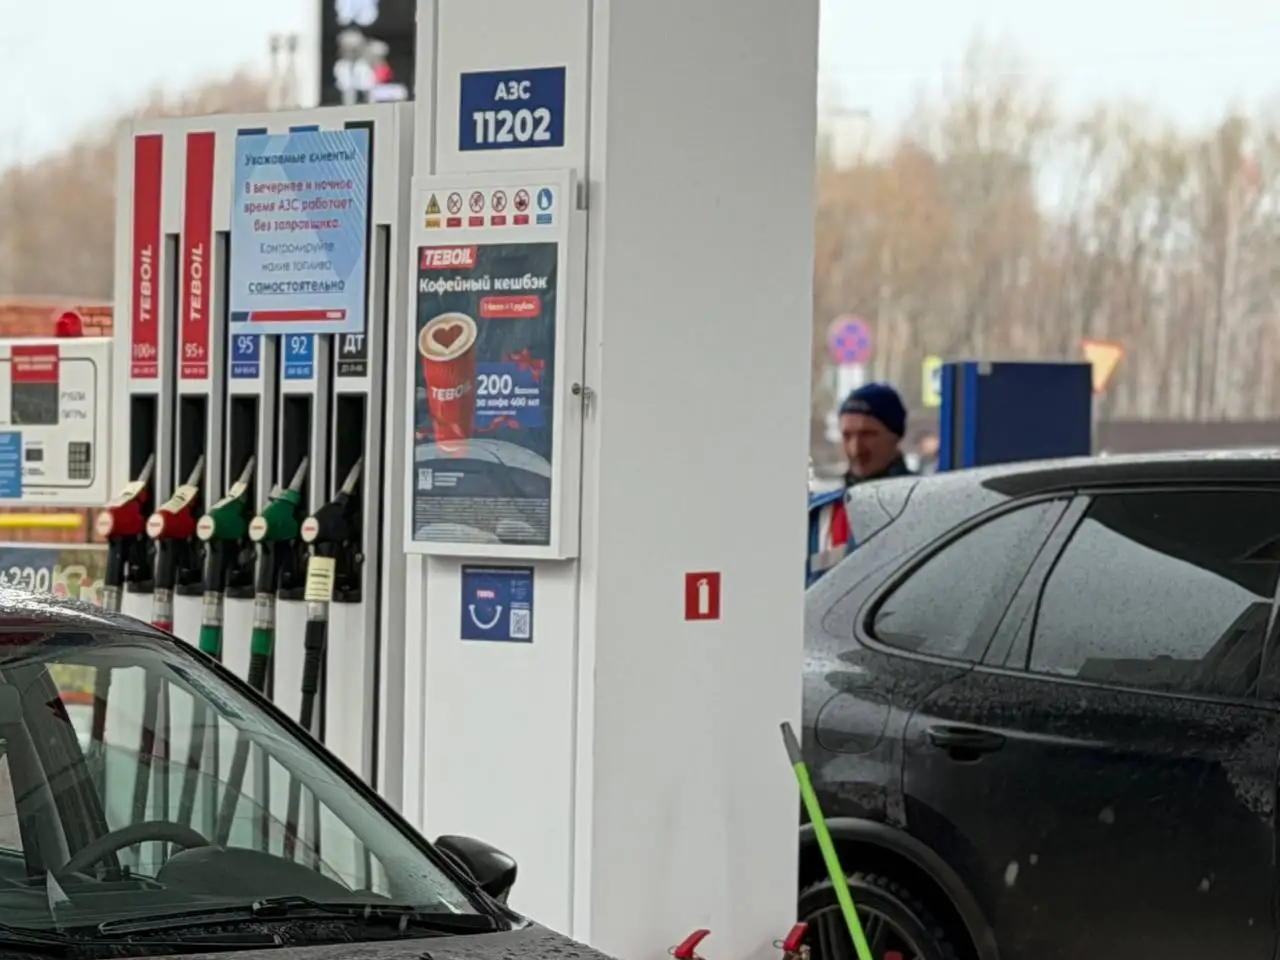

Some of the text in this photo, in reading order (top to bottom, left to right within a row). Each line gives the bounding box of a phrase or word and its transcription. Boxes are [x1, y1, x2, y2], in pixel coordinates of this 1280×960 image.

[494, 80, 532, 101] АЗС
[472, 106, 551, 144] 11202
[278, 199, 299, 211] АЗС
[301, 198, 353, 212] работает
[424, 248, 473, 266] TEBOIL
[139, 244, 152, 322] TEBOIL
[190, 242, 203, 321] TEBOIL
[248, 280, 346, 293] самостоятельно
[420, 272, 548, 295] Кофейный кешбэк
[238, 336, 254, 354] 95
[291, 336, 308, 354] 92
[343, 334, 365, 353] ДТ
[477, 374, 512, 395] 200
